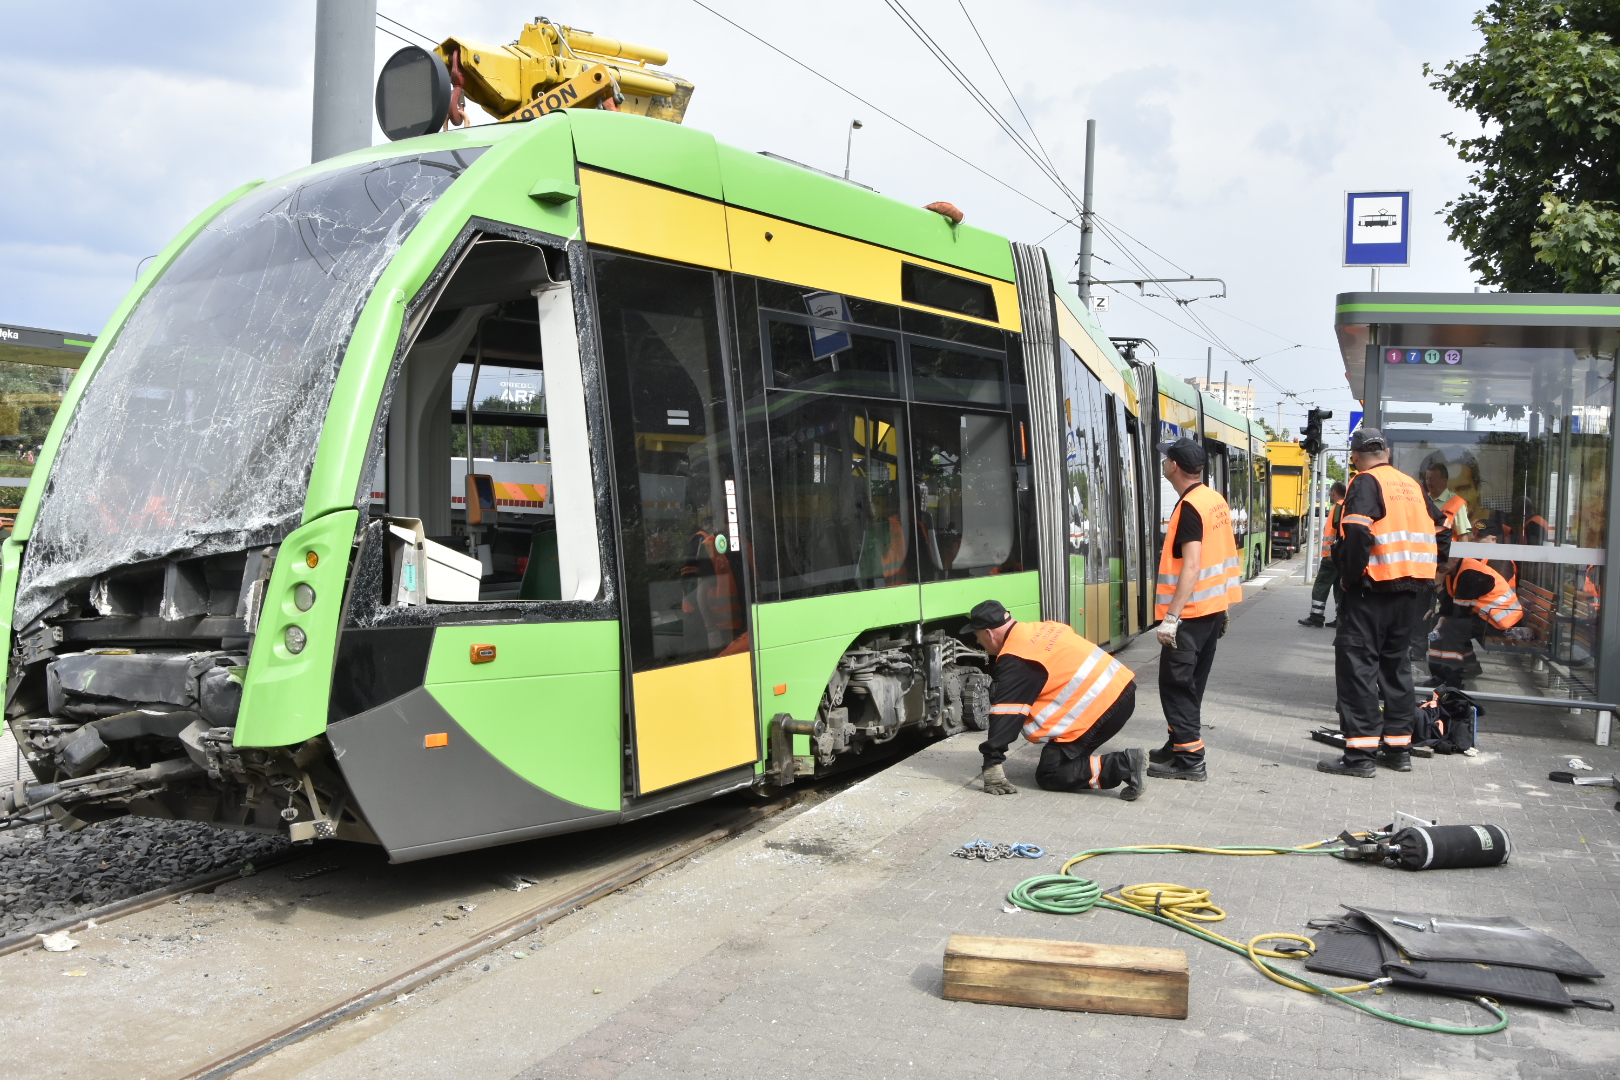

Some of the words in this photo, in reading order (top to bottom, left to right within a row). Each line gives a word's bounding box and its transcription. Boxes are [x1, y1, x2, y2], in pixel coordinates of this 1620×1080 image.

[1096, 297, 1106, 307] Z
[1391, 352, 1396, 360] 1
[1410, 352, 1417, 361] 7
[1447, 353, 1458, 361] 12
